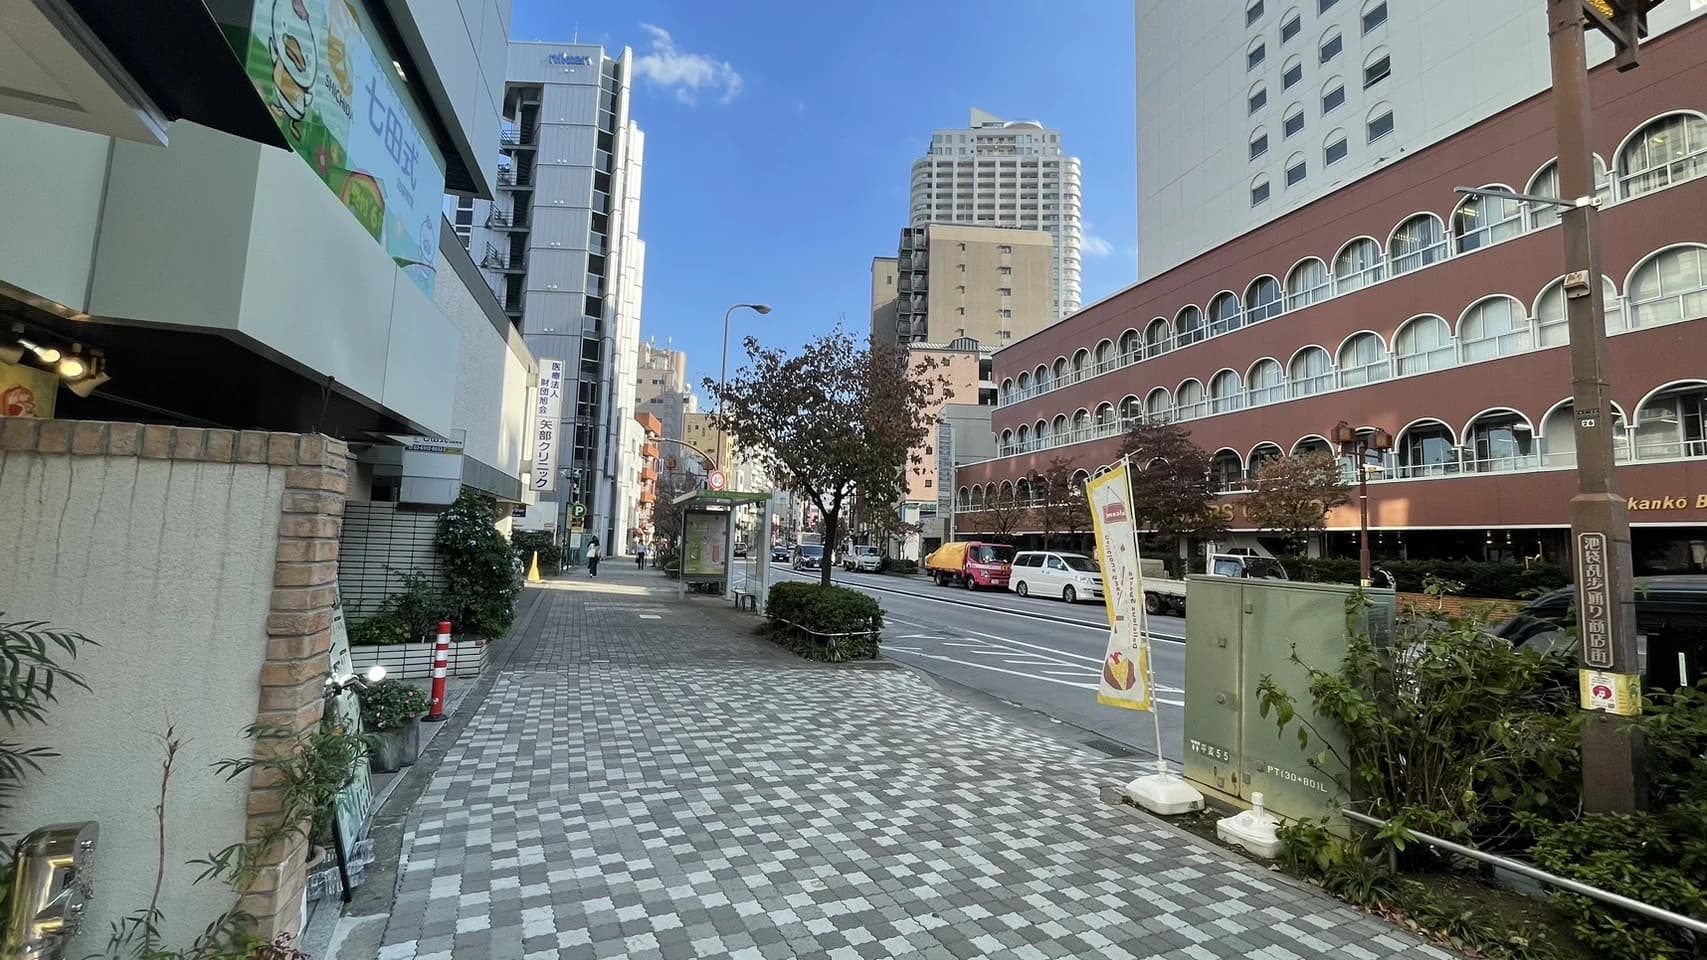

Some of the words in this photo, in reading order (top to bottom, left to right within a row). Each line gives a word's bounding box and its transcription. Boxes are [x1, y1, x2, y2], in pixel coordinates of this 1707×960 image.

[366, 76, 421, 191] 七田式
[550, 362, 562, 399] 医療法人
[535, 419, 552, 489] 矢部クリニック
[575, 506, 583, 515] P
[1584, 537, 1608, 663] 池袋乱歩通り商店街
